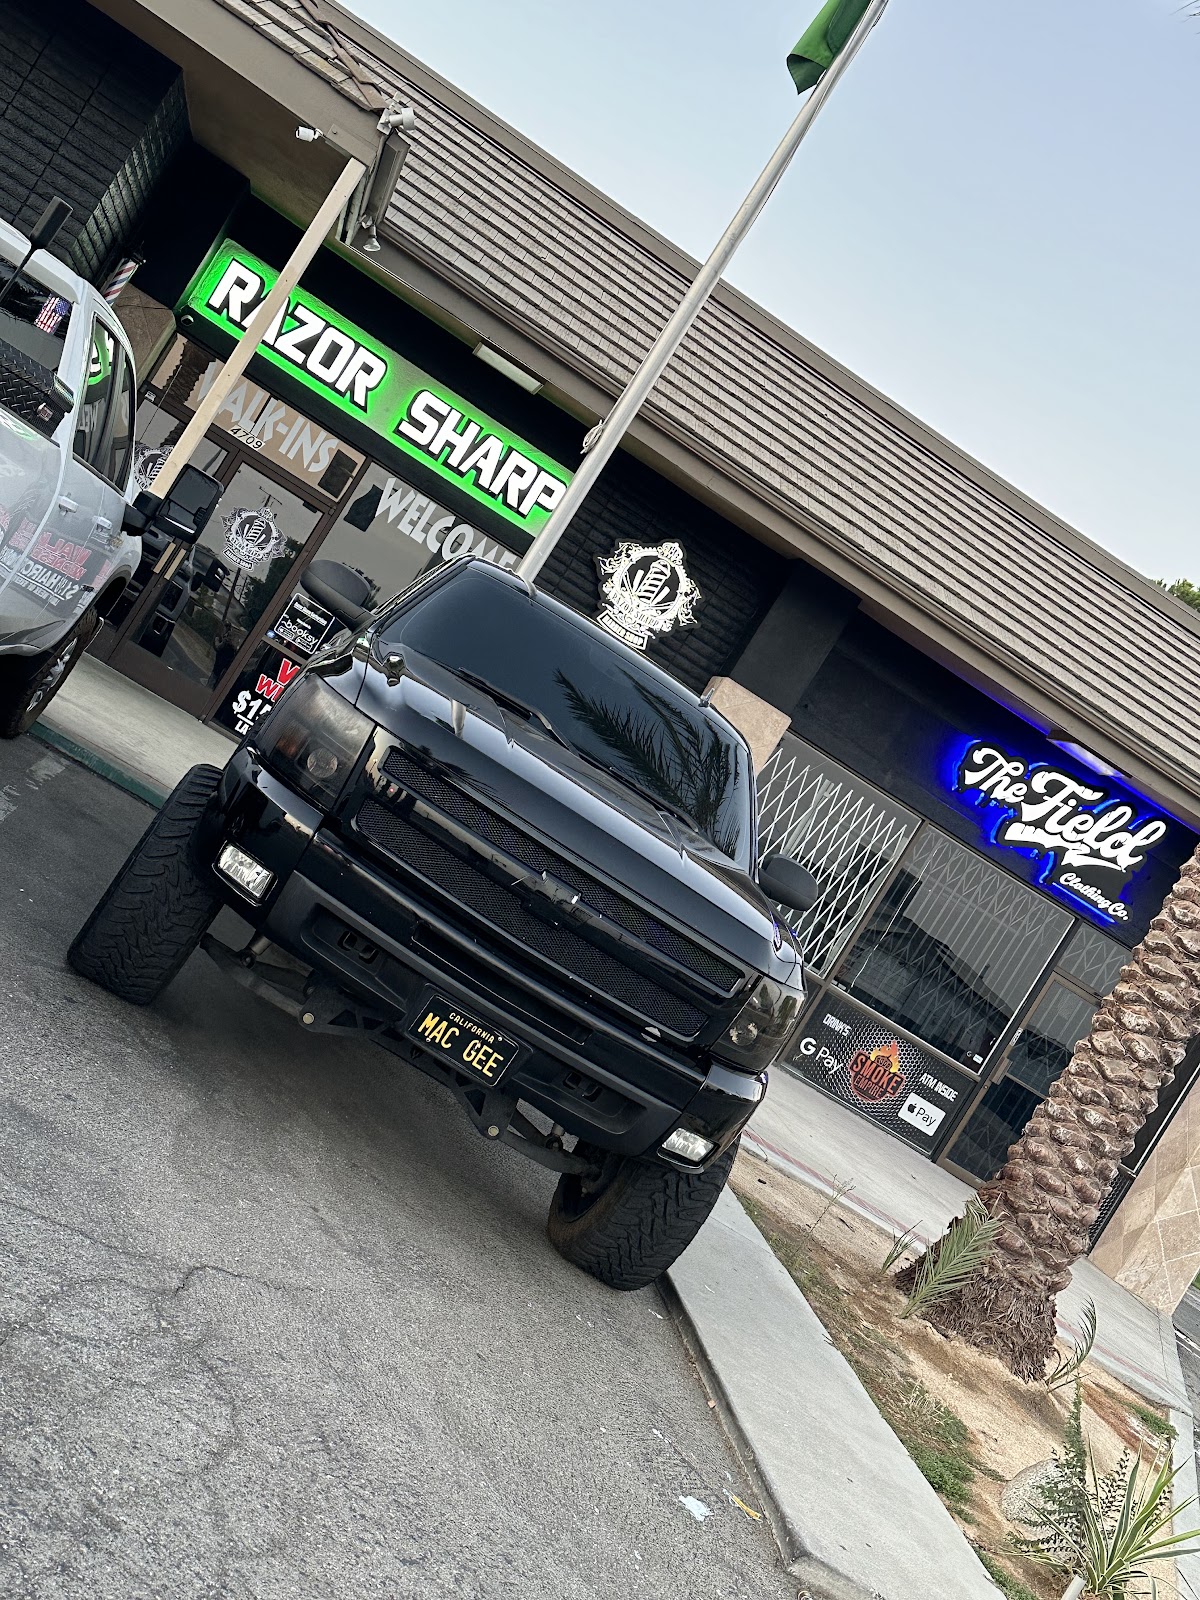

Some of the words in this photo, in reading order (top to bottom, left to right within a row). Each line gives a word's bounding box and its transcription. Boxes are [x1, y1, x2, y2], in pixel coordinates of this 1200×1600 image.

[230, 428, 263, 450] 4709
[398, 390, 567, 516] SHARP
[282, 619, 319, 645] booksy
[964, 747, 1028, 804] The
[1021, 771, 1167, 869] Field
[1059, 872, 1111, 910] Clothing
[417, 1011, 460, 1049] MAC
[462, 1039, 505, 1078] GEE
[449, 1011, 495, 1044] CALIFORNIA
[800, 1037, 817, 1056] G
[816, 1047, 845, 1075] Pay
[853, 1055, 901, 1095] SMOKE
[853, 1074, 886, 1100] EMPIRE
[918, 1072, 937, 1090] ATM
[934, 1081, 959, 1103] INSIDE
[915, 1108, 937, 1127] Pay
